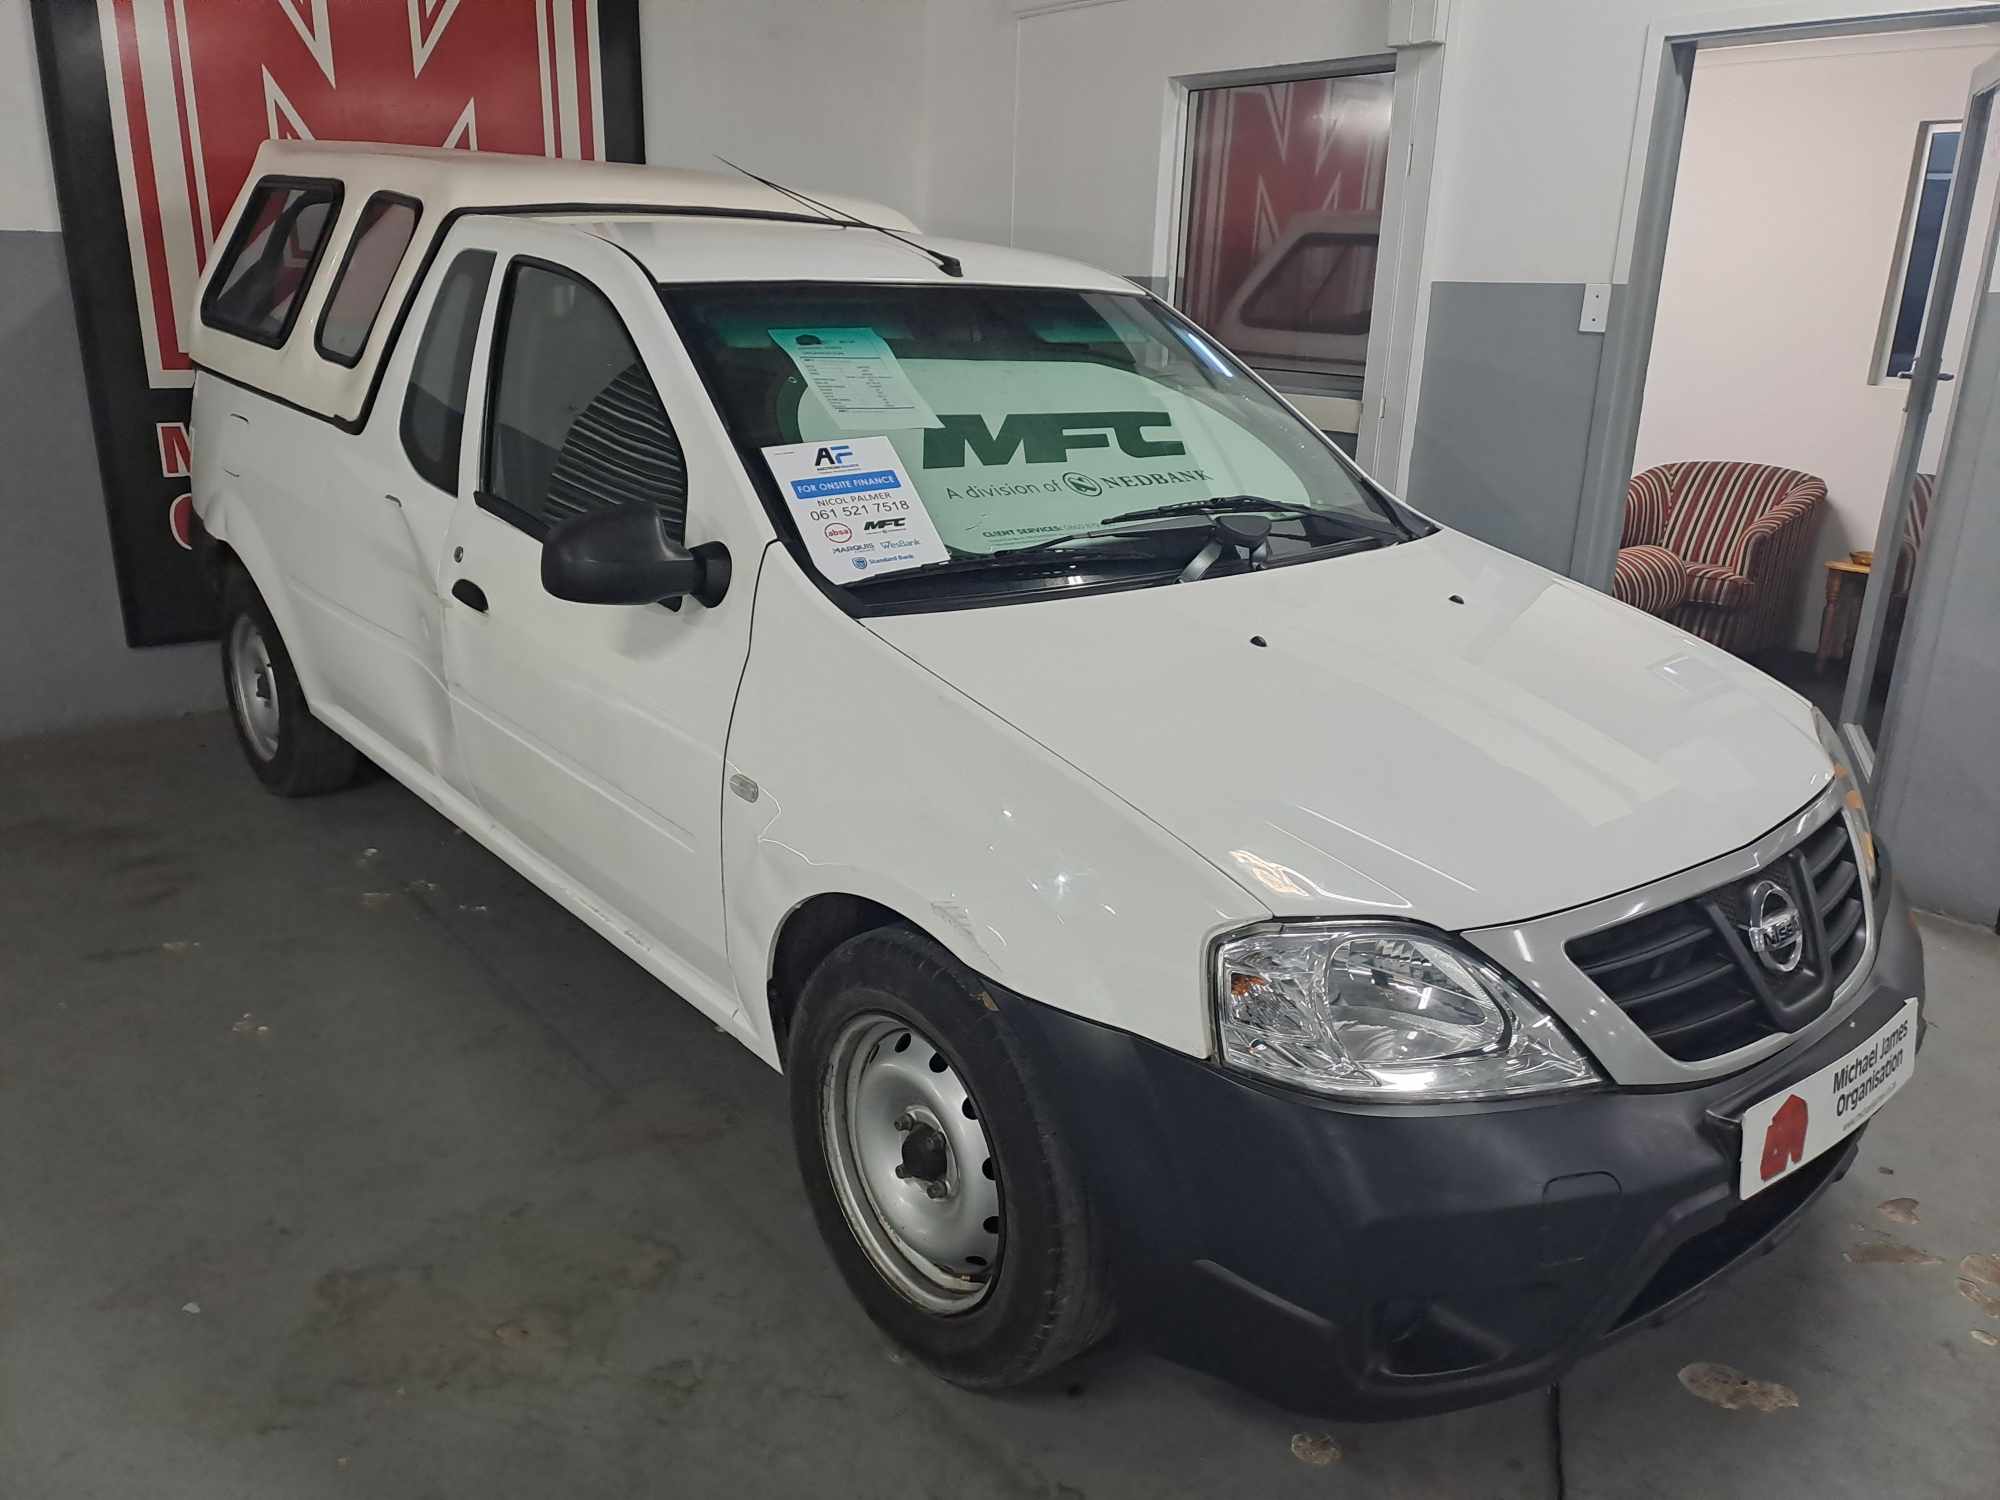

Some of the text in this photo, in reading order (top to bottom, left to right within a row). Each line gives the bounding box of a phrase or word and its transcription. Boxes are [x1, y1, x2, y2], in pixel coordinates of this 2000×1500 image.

[923, 411, 1186, 470] MFC
[797, 475, 895, 494] FOR ONSITE FINANCE
[946, 469, 1213, 501] A division of NEDBANK
[810, 500, 910, 521] 061 521 7518
[817, 491, 892, 507] NICOL PALMER
[828, 517, 907, 537] absa MFC
[1833, 1019, 1908, 1094] Michael James
[1836, 1048, 1904, 1117] Organisation
